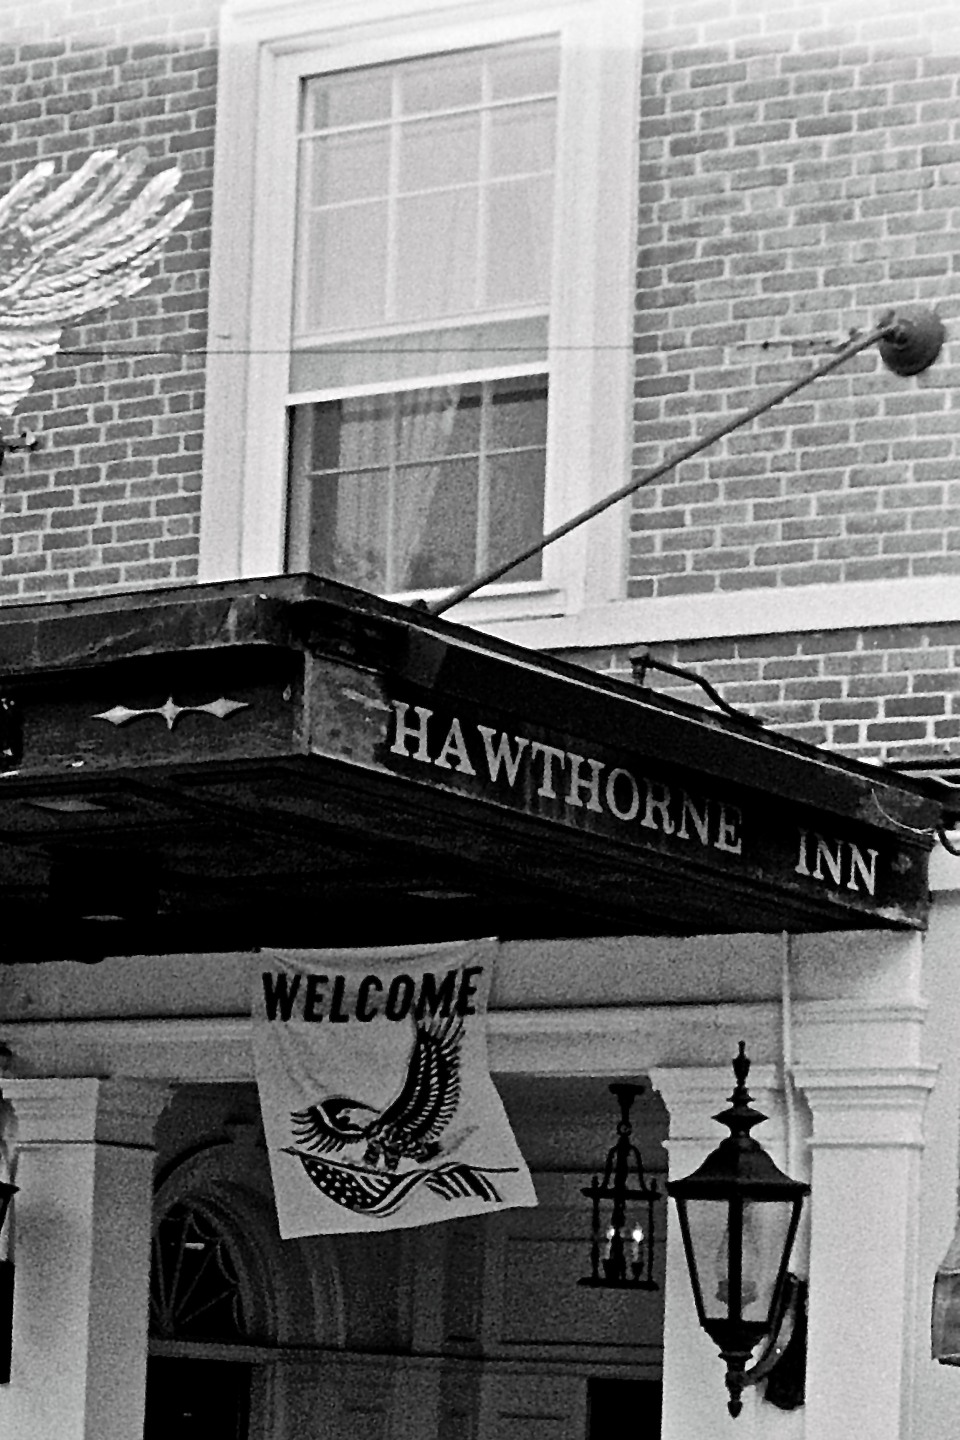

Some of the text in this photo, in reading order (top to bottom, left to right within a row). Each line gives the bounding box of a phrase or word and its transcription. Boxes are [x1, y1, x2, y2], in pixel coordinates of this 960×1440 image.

[389, 698, 879, 896] HAWTHORNE INN
[262, 966, 484, 1023] WELCOME
